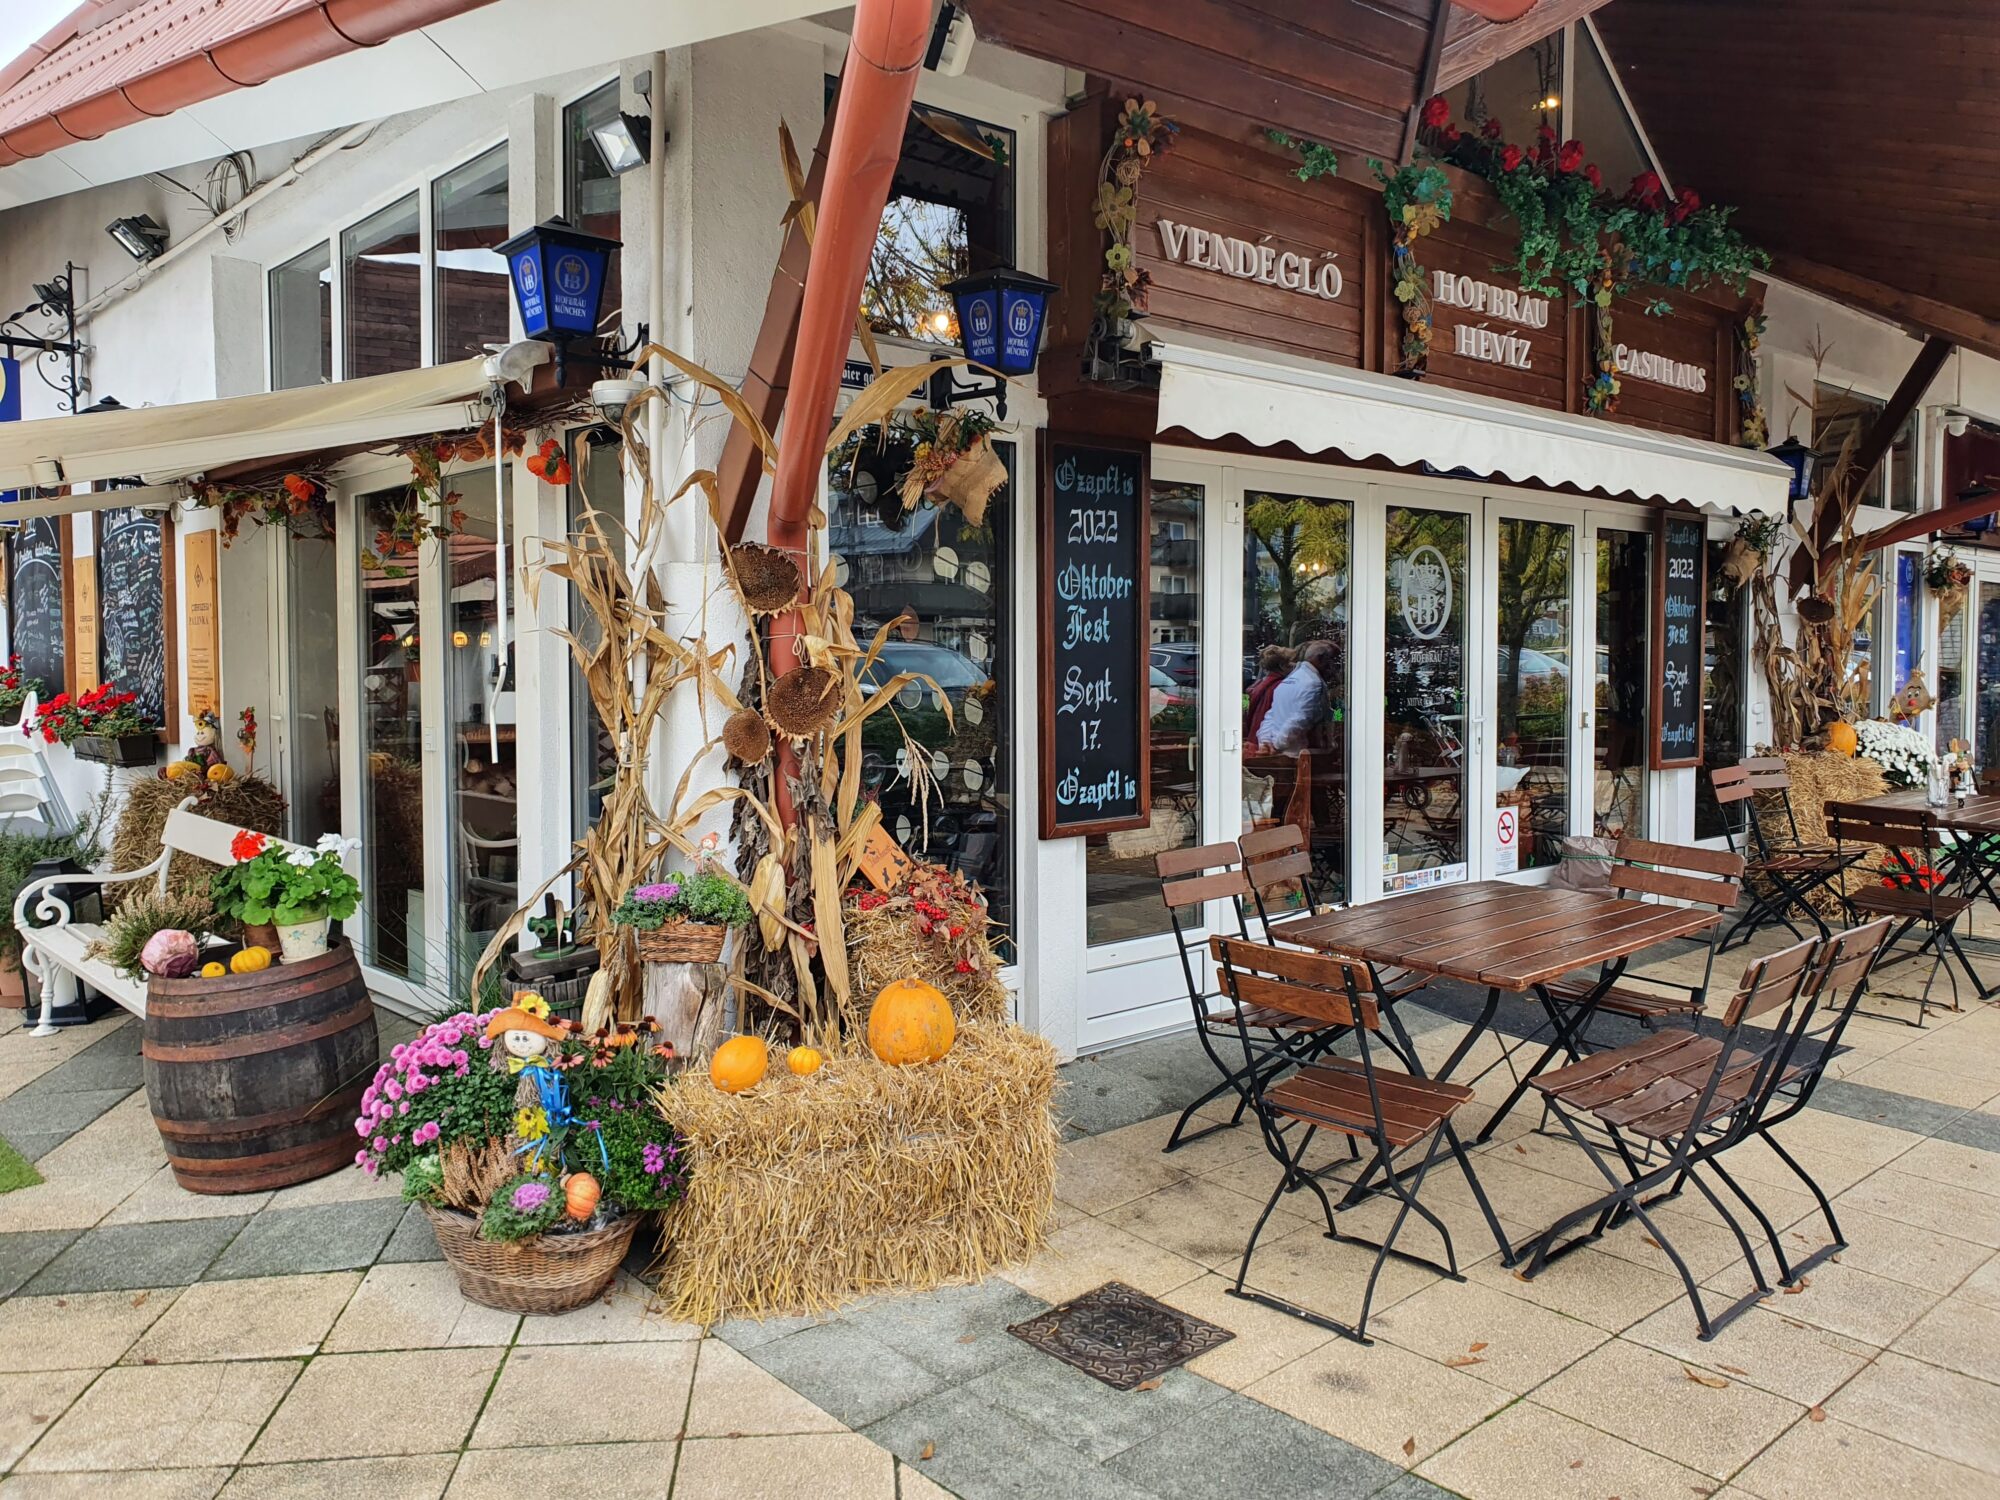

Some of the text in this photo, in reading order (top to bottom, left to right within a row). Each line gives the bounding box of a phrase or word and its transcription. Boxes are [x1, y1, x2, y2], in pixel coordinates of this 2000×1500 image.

[1157, 218, 1343, 300] VENDÉGLŐ
[554, 303, 587, 318] MÜNCHEN
[1453, 322, 1532, 370] HÉVÍZ
[1612, 343, 1707, 393] GASTHAUS
[1068, 508, 1118, 545] 2022
[1057, 557, 1133, 601] Oktober
[1669, 557, 1694, 580] 2022
[1063, 603, 1111, 650] Fest
[1665, 594, 1697, 619] Oktober
[1667, 624, 1689, 648] Fest
[1057, 665, 1118, 715] Sept.
[1080, 719, 1102, 750] 17.
